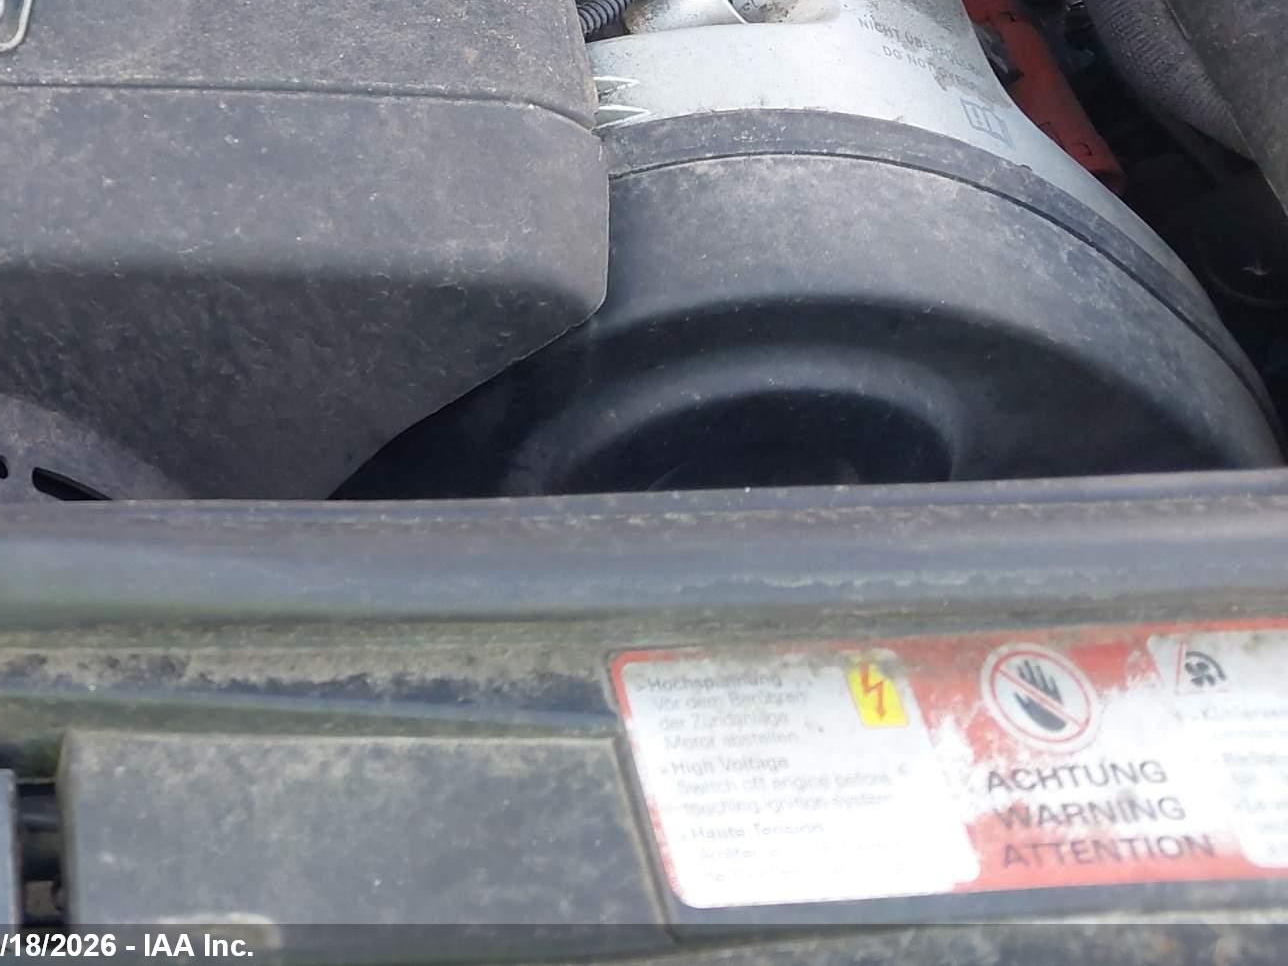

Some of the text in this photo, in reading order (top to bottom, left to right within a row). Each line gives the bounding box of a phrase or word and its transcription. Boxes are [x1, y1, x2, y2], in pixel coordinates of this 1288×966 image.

[671, 755, 790, 777] High Voltage
[987, 759, 1168, 793] ACHTUNG
[994, 795, 1187, 830] WARNING
[1003, 833, 1218, 869] ATTENTION
